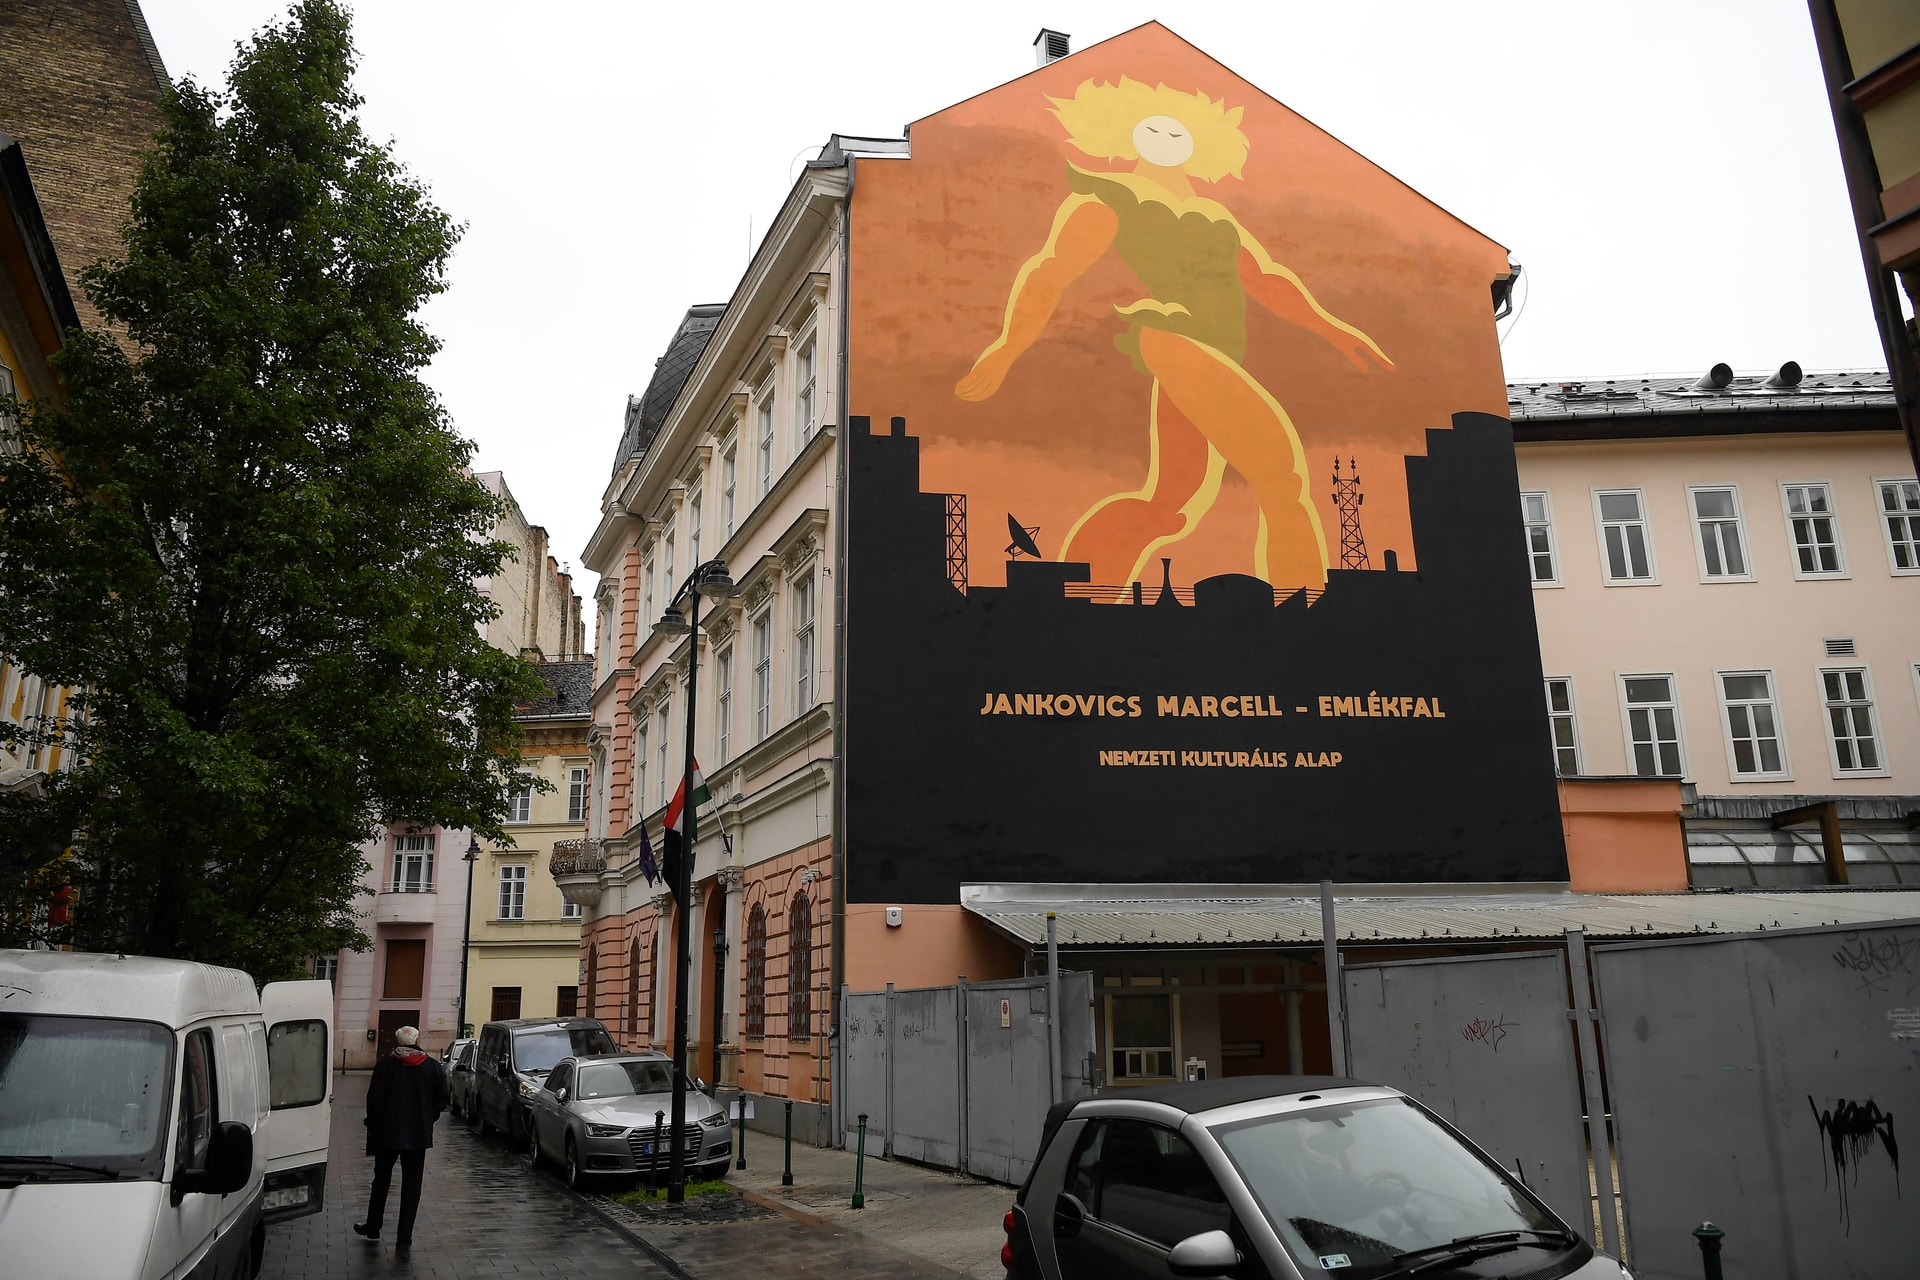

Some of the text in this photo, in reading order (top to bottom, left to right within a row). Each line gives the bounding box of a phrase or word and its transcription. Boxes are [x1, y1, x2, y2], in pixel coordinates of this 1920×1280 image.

[980, 693, 1142, 717] JANKOVICS
[1157, 695, 1283, 717] MARCELL
[1318, 691, 1446, 718] EMLÉKFAL
[1099, 748, 1343, 768] NEMZETI KULTURÁLIS ALAP
